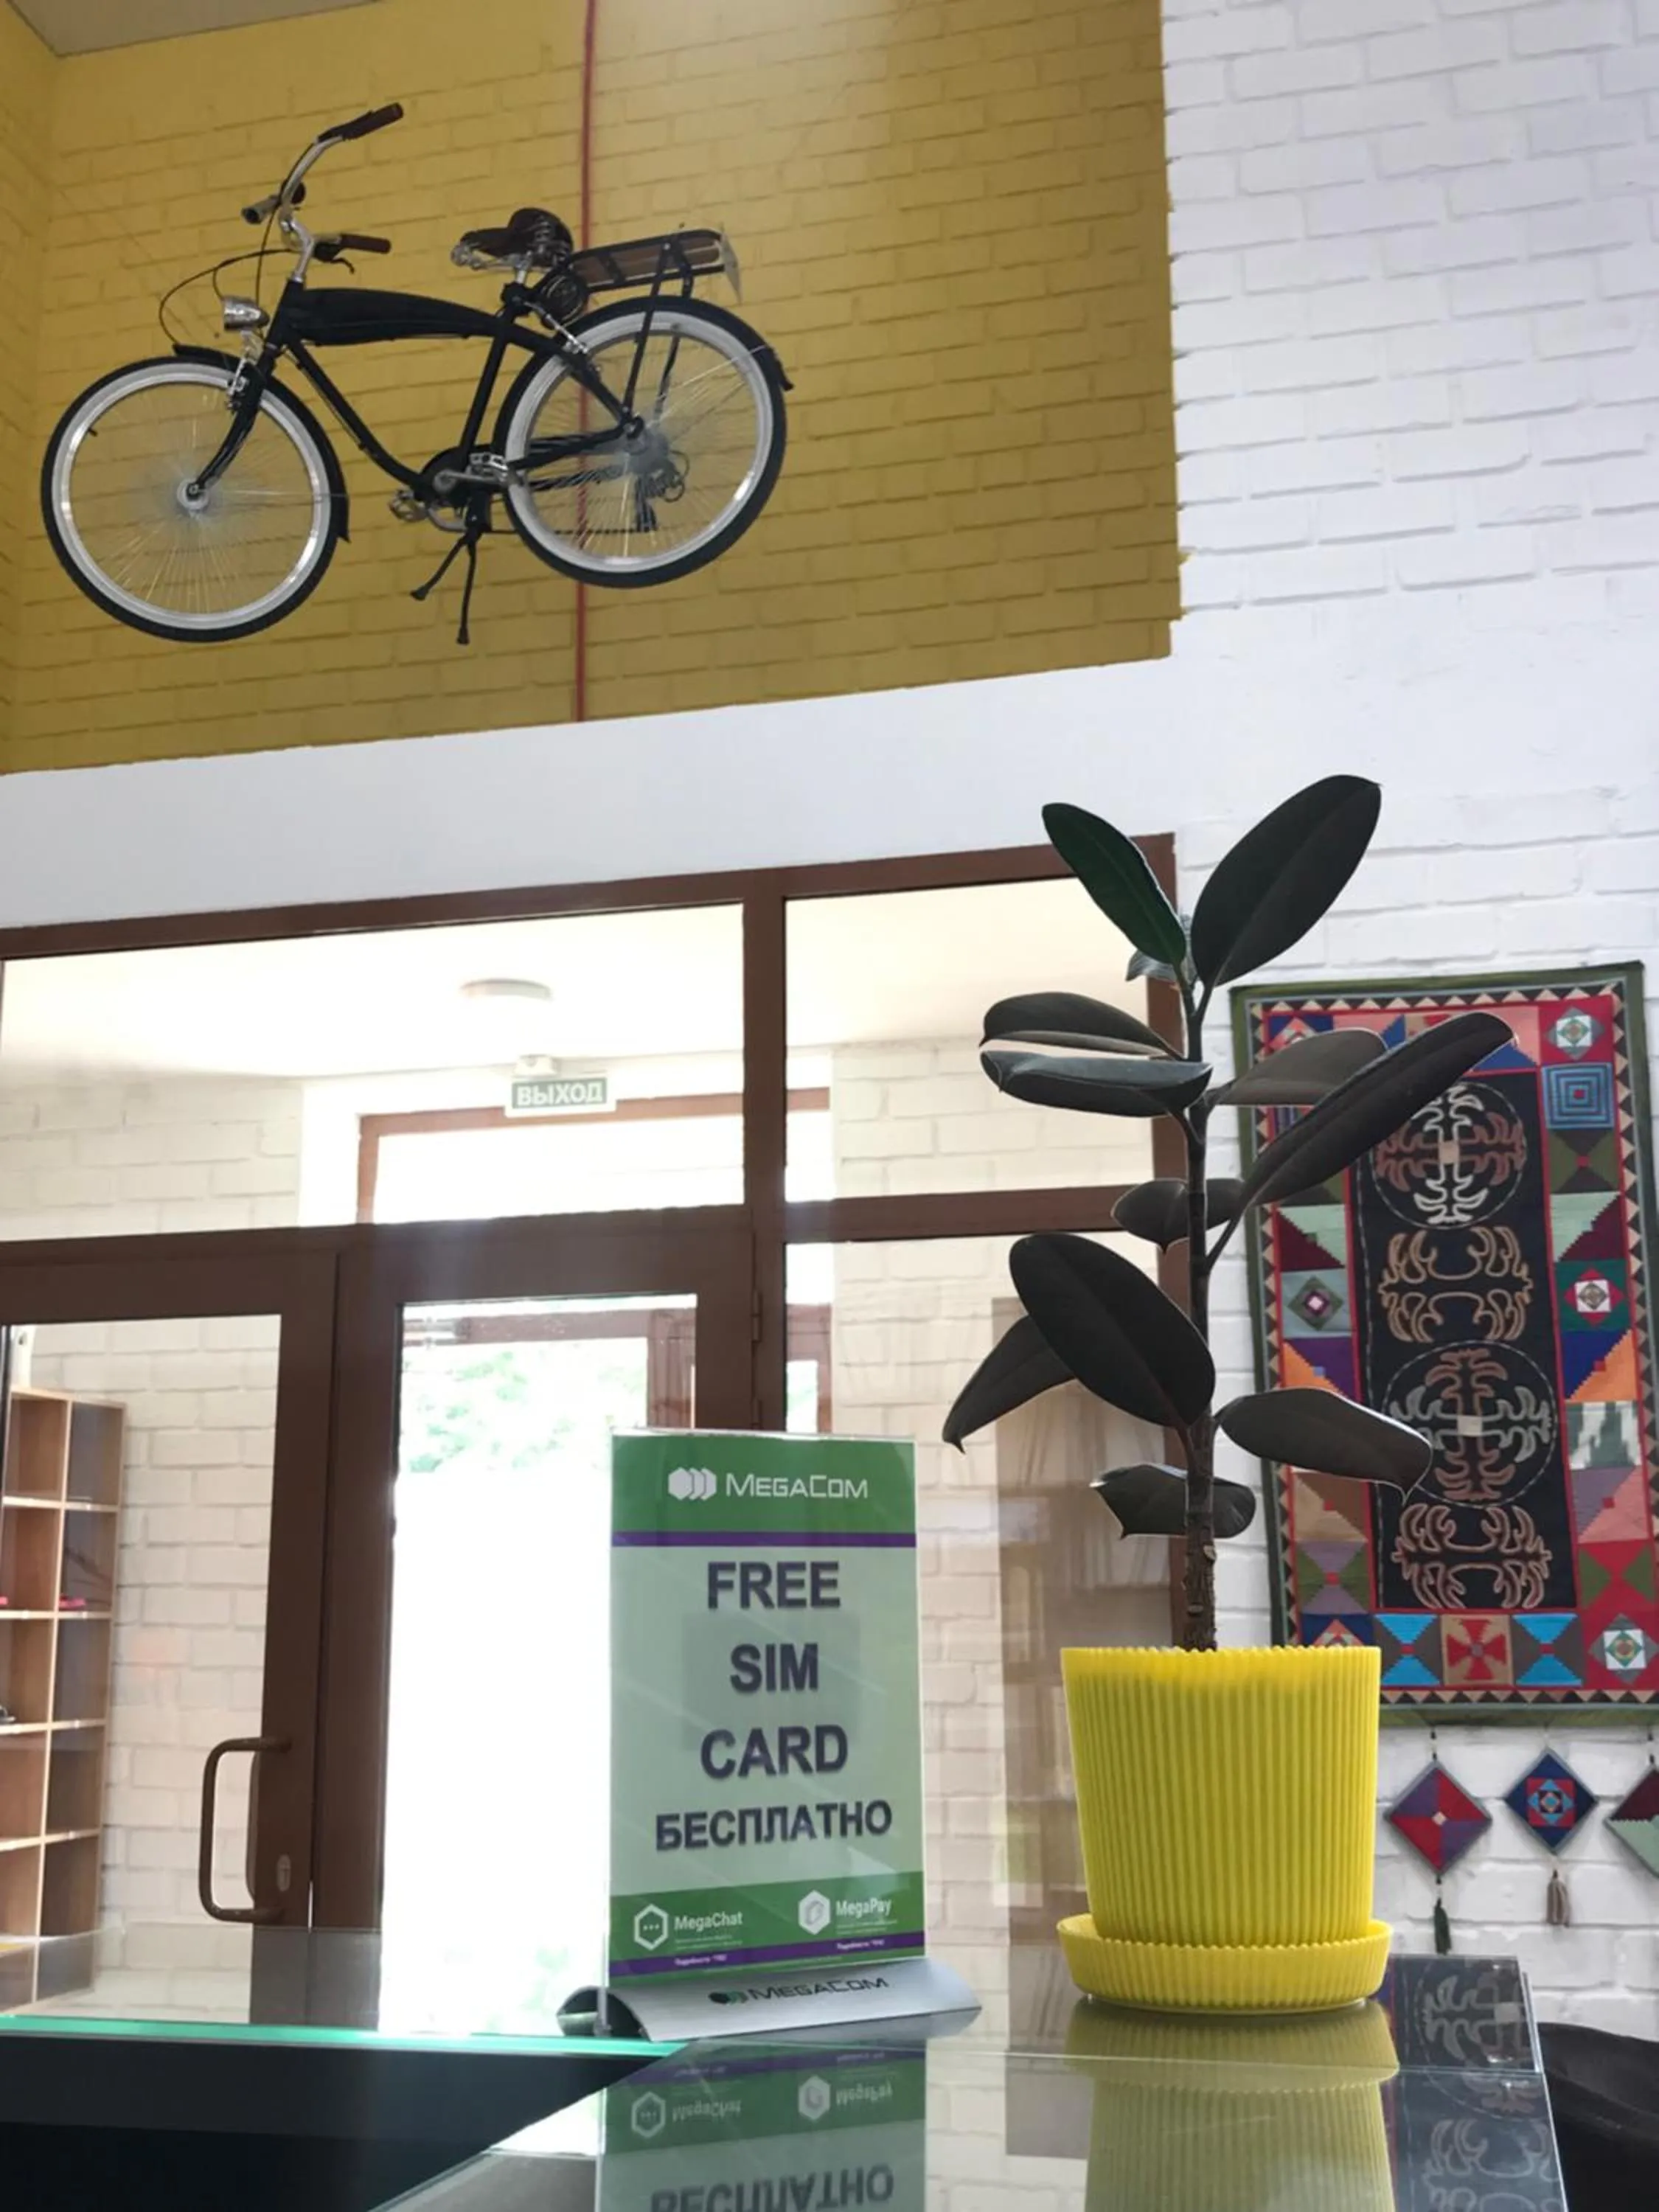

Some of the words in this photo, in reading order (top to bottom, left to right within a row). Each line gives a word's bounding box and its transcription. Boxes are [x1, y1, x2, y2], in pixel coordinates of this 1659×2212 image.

[516, 1082, 604, 1107] ВЫХОД
[707, 1560, 841, 1610] FREE
[729, 1642, 819, 1694] SIM
[700, 1724, 849, 1780] CARD
[655, 1799, 893, 1852] БЕСПЛАТНО
[674, 1910, 743, 1933] MegaChat
[835, 1897, 892, 1919] MegaPay
